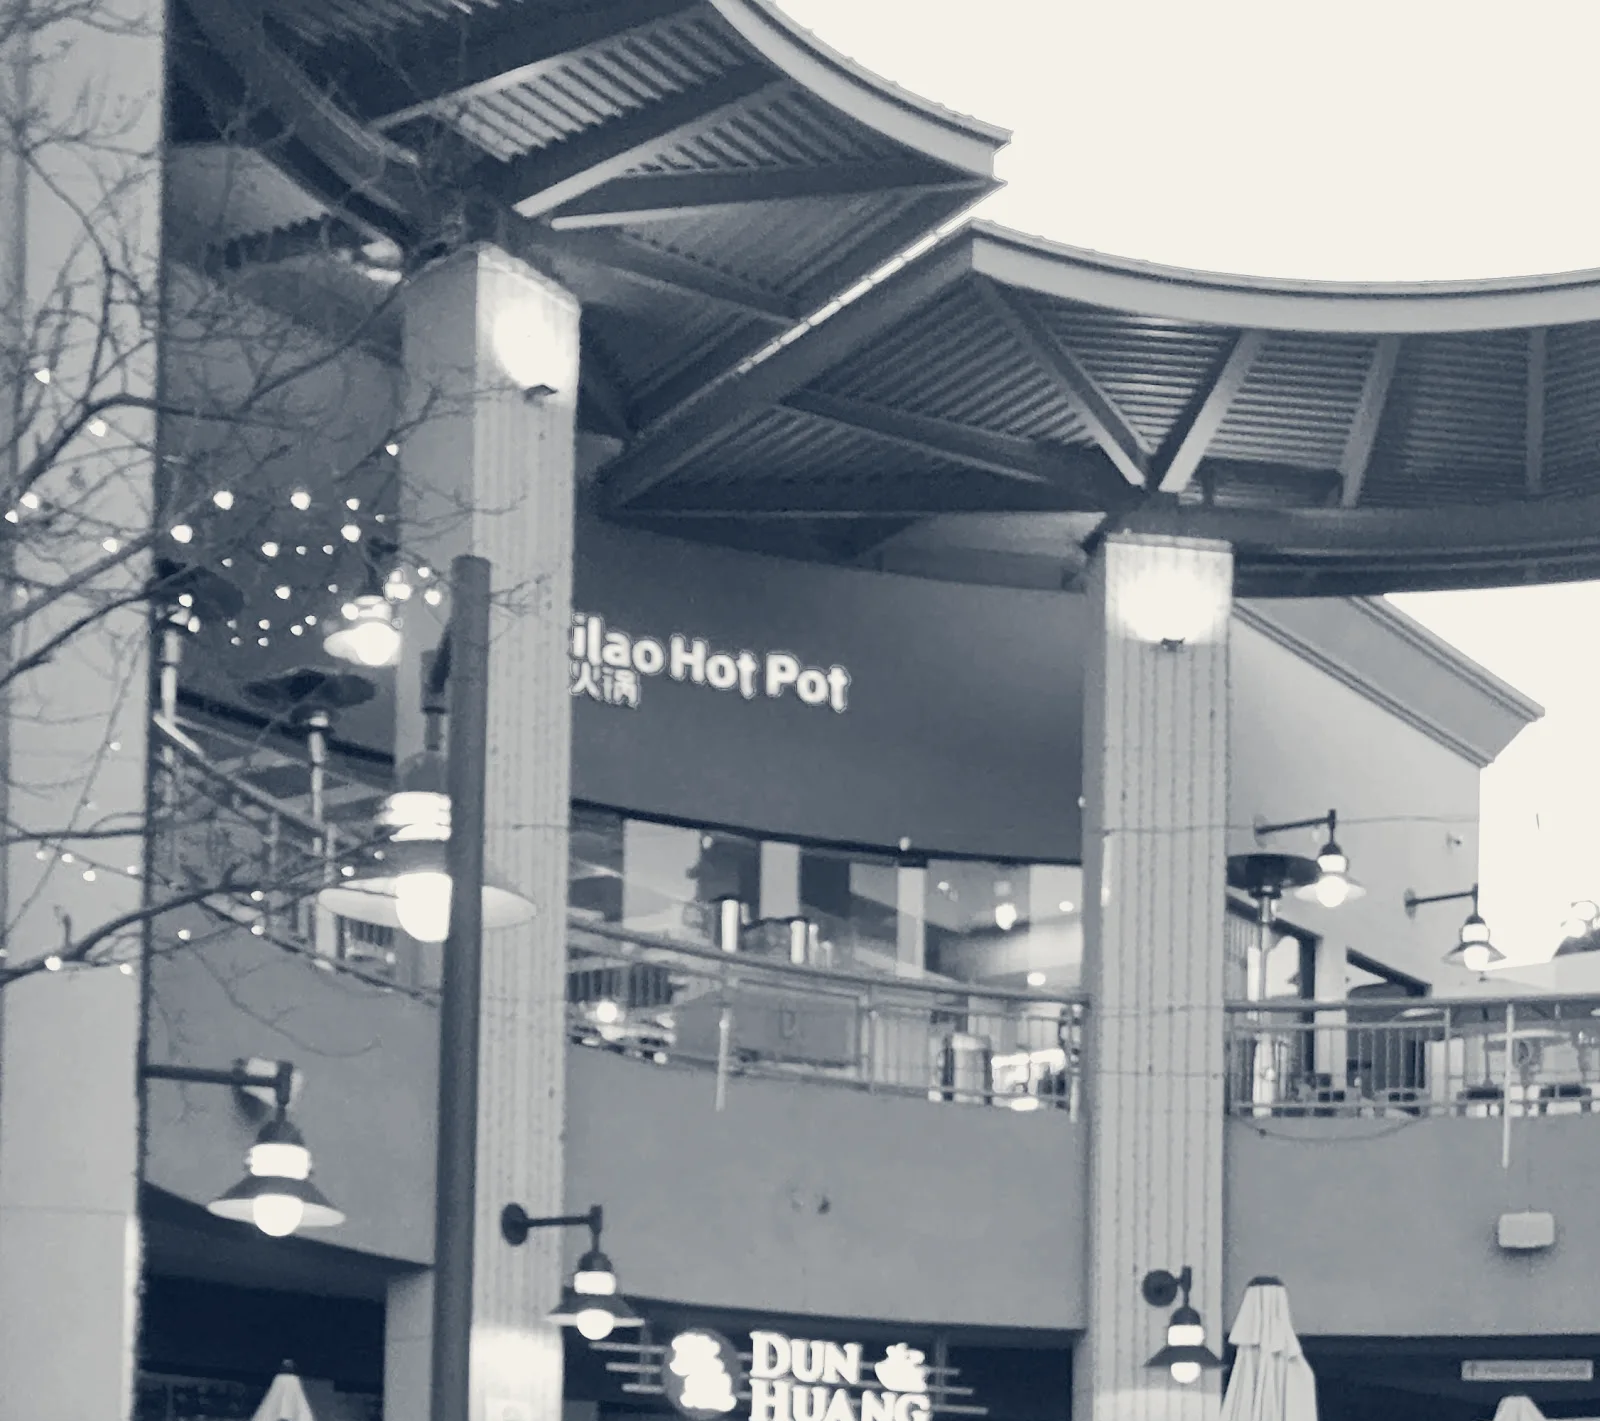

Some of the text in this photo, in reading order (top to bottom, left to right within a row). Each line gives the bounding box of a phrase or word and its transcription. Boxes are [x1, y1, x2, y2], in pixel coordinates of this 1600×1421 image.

[669, 635, 757, 698] Hot
[766, 653, 849, 711] Pot
[749, 1331, 860, 1384] DUN
